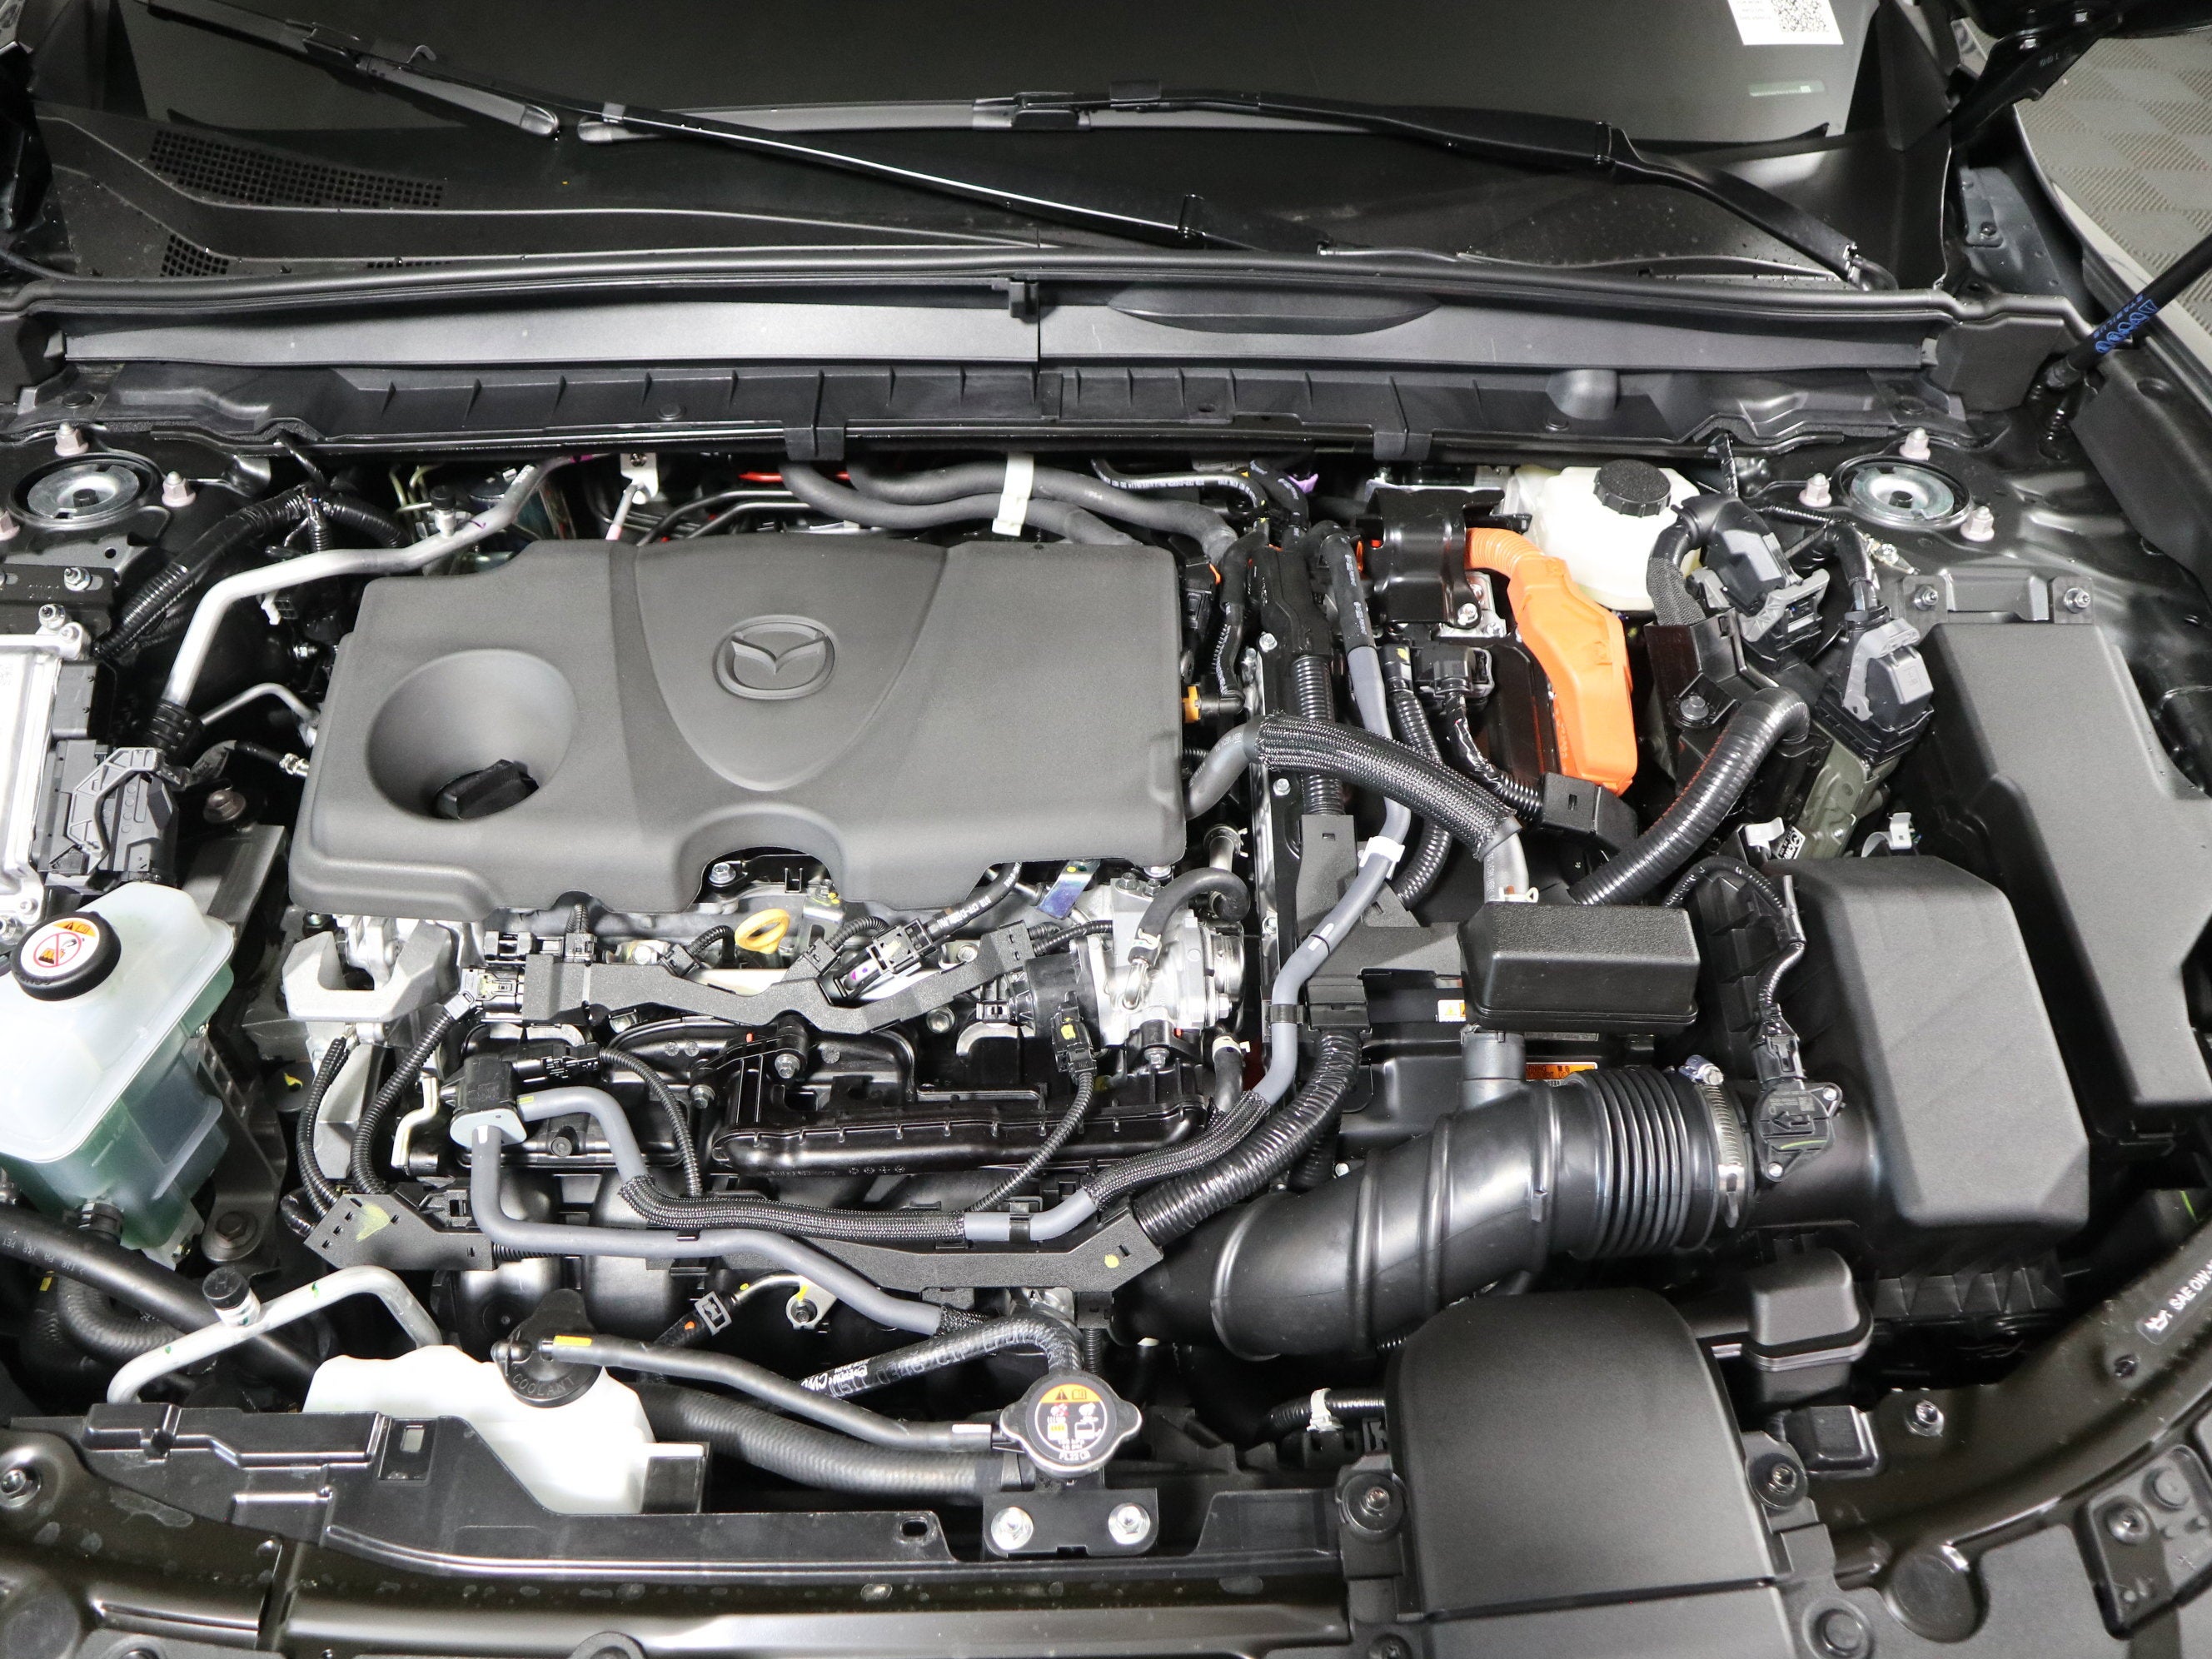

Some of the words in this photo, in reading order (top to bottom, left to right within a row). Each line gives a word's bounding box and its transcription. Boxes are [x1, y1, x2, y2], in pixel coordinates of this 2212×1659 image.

[2093, 293, 2144, 338] STABILUS
[2, 1236, 17, 1248] PET
[2169, 1286, 2197, 1311] SAE
[512, 1373, 575, 1396] COOLANT
